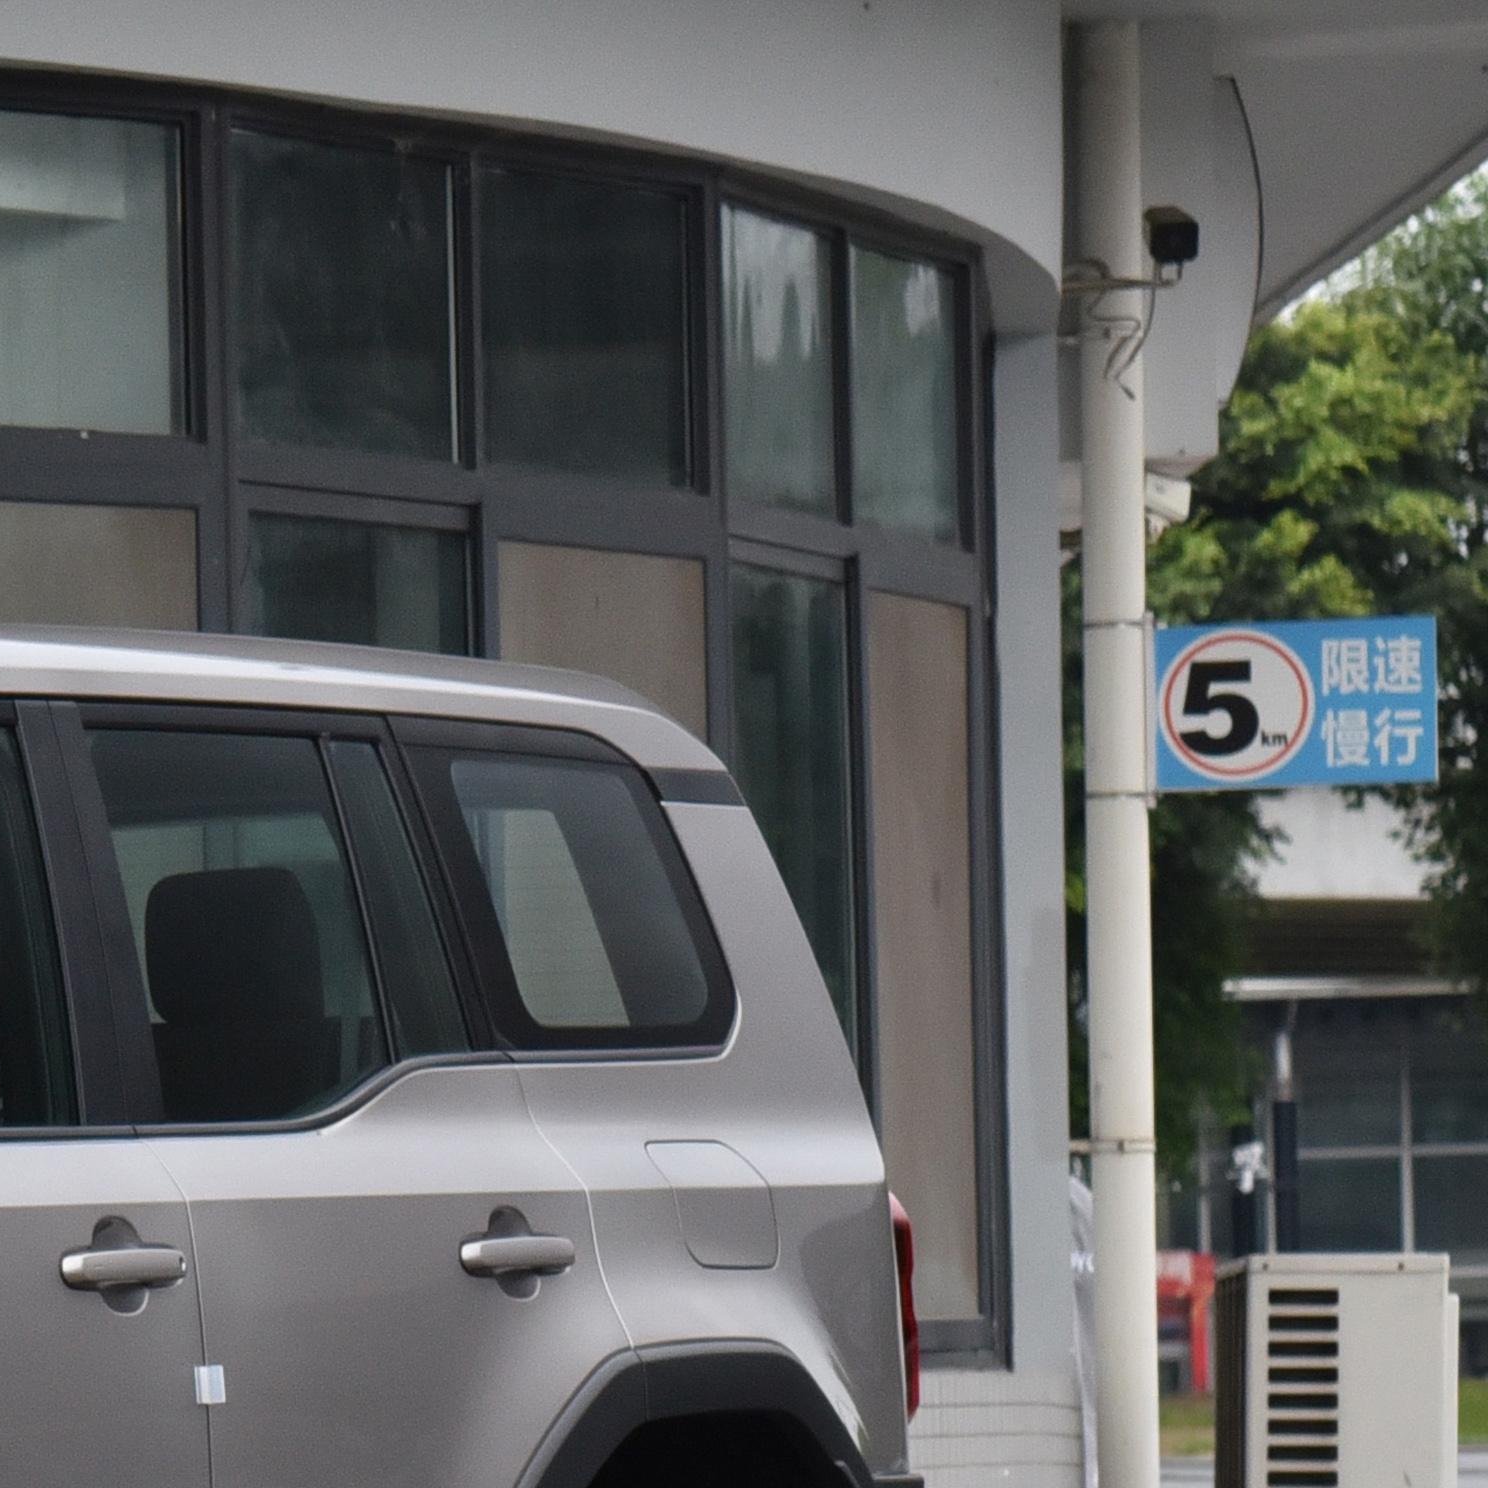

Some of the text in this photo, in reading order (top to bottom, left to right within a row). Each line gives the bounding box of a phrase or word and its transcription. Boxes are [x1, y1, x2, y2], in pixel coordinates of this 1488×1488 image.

[1321, 636, 1423, 696] 限速
[1179, 660, 1259, 756] 5
[1321, 707, 1423, 768] 慢行
